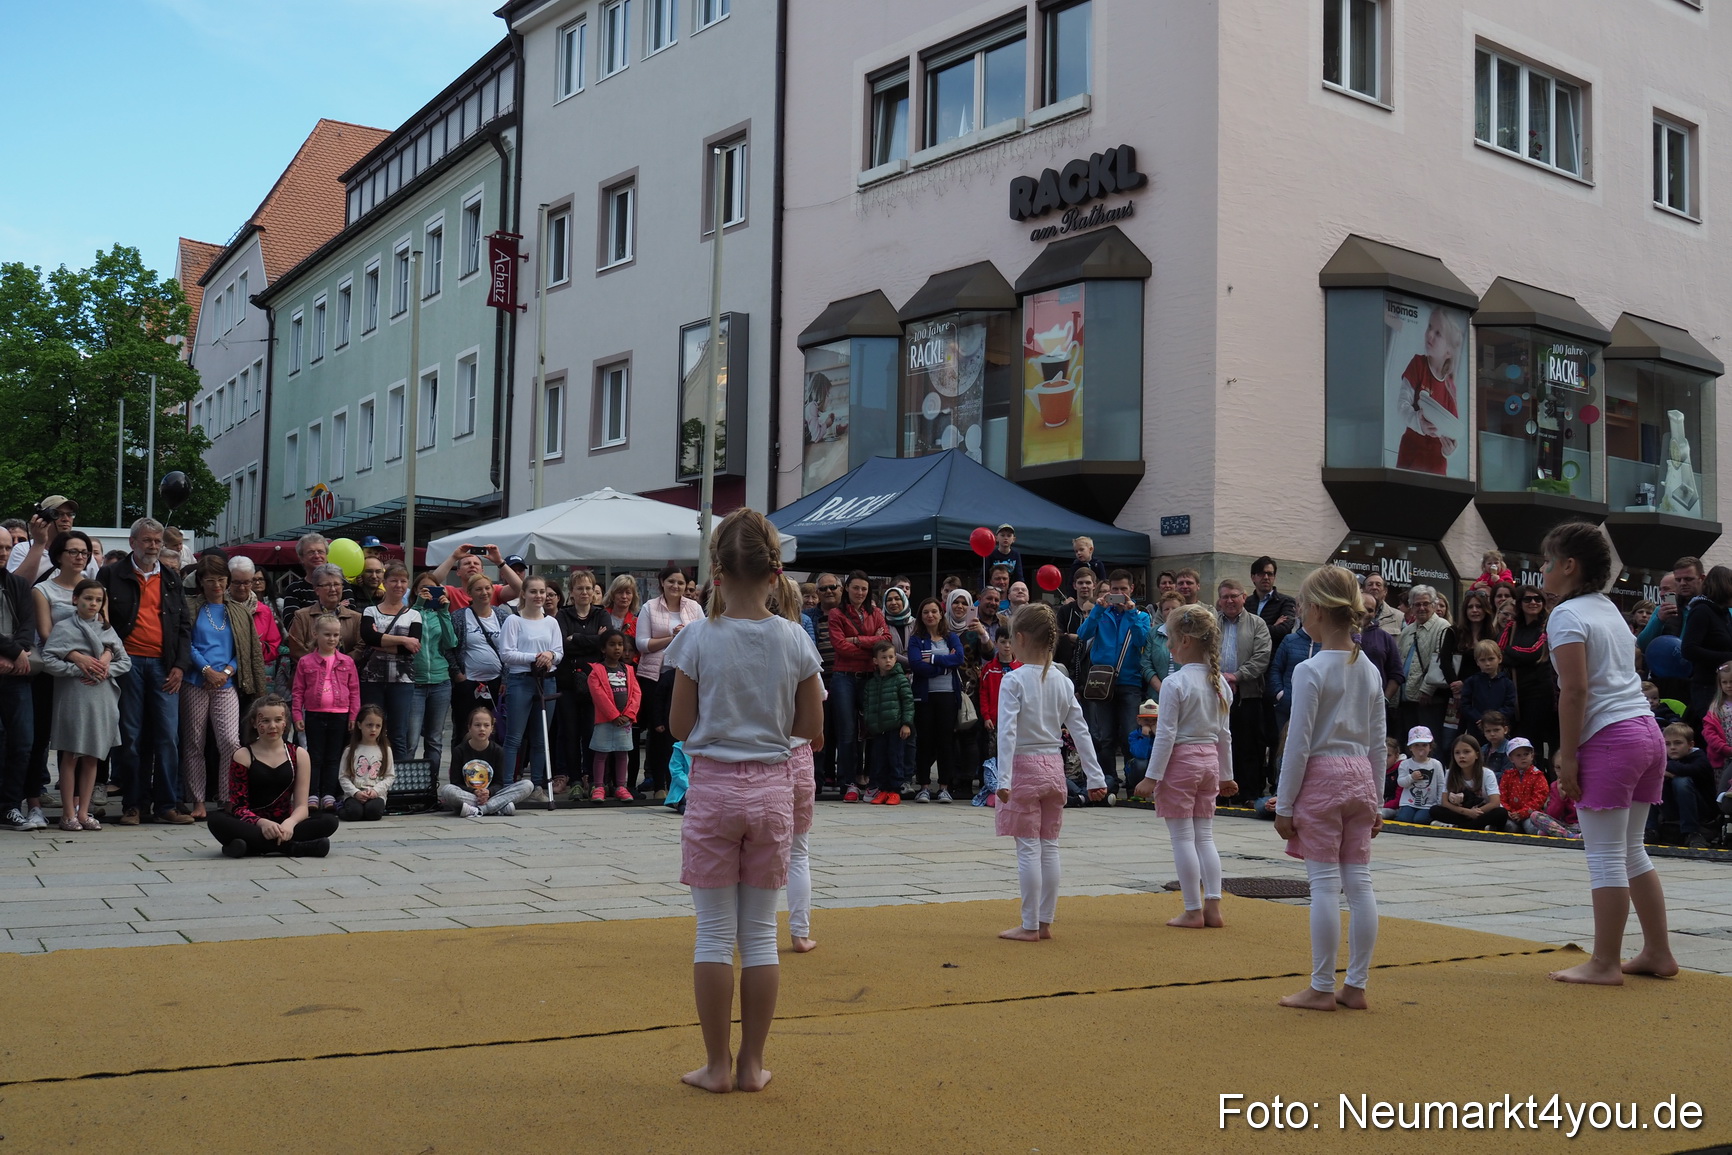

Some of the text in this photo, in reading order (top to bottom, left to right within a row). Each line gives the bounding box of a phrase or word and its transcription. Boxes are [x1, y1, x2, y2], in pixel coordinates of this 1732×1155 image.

[1010, 144, 1147, 221] RACKL
[1030, 200, 1135, 241] am Rathaus
[495, 248, 511, 303] Achatz
[1386, 299, 1418, 318] Thomas
[914, 321, 950, 343] 100 Jahre
[910, 339, 944, 369] RACKL
[1552, 344, 1584, 356] 100 Jahre
[1549, 356, 1579, 385] RACKL
[305, 491, 335, 526] RENO
[802, 492, 897, 522] RACKL
[1333, 559, 1370, 571] Willkommen
[1371, 562, 1380, 572] im
[1381, 557, 1412, 583] RACKL
[1521, 570, 1543, 589] RACK
[1643, 584, 1662, 606] RACK
